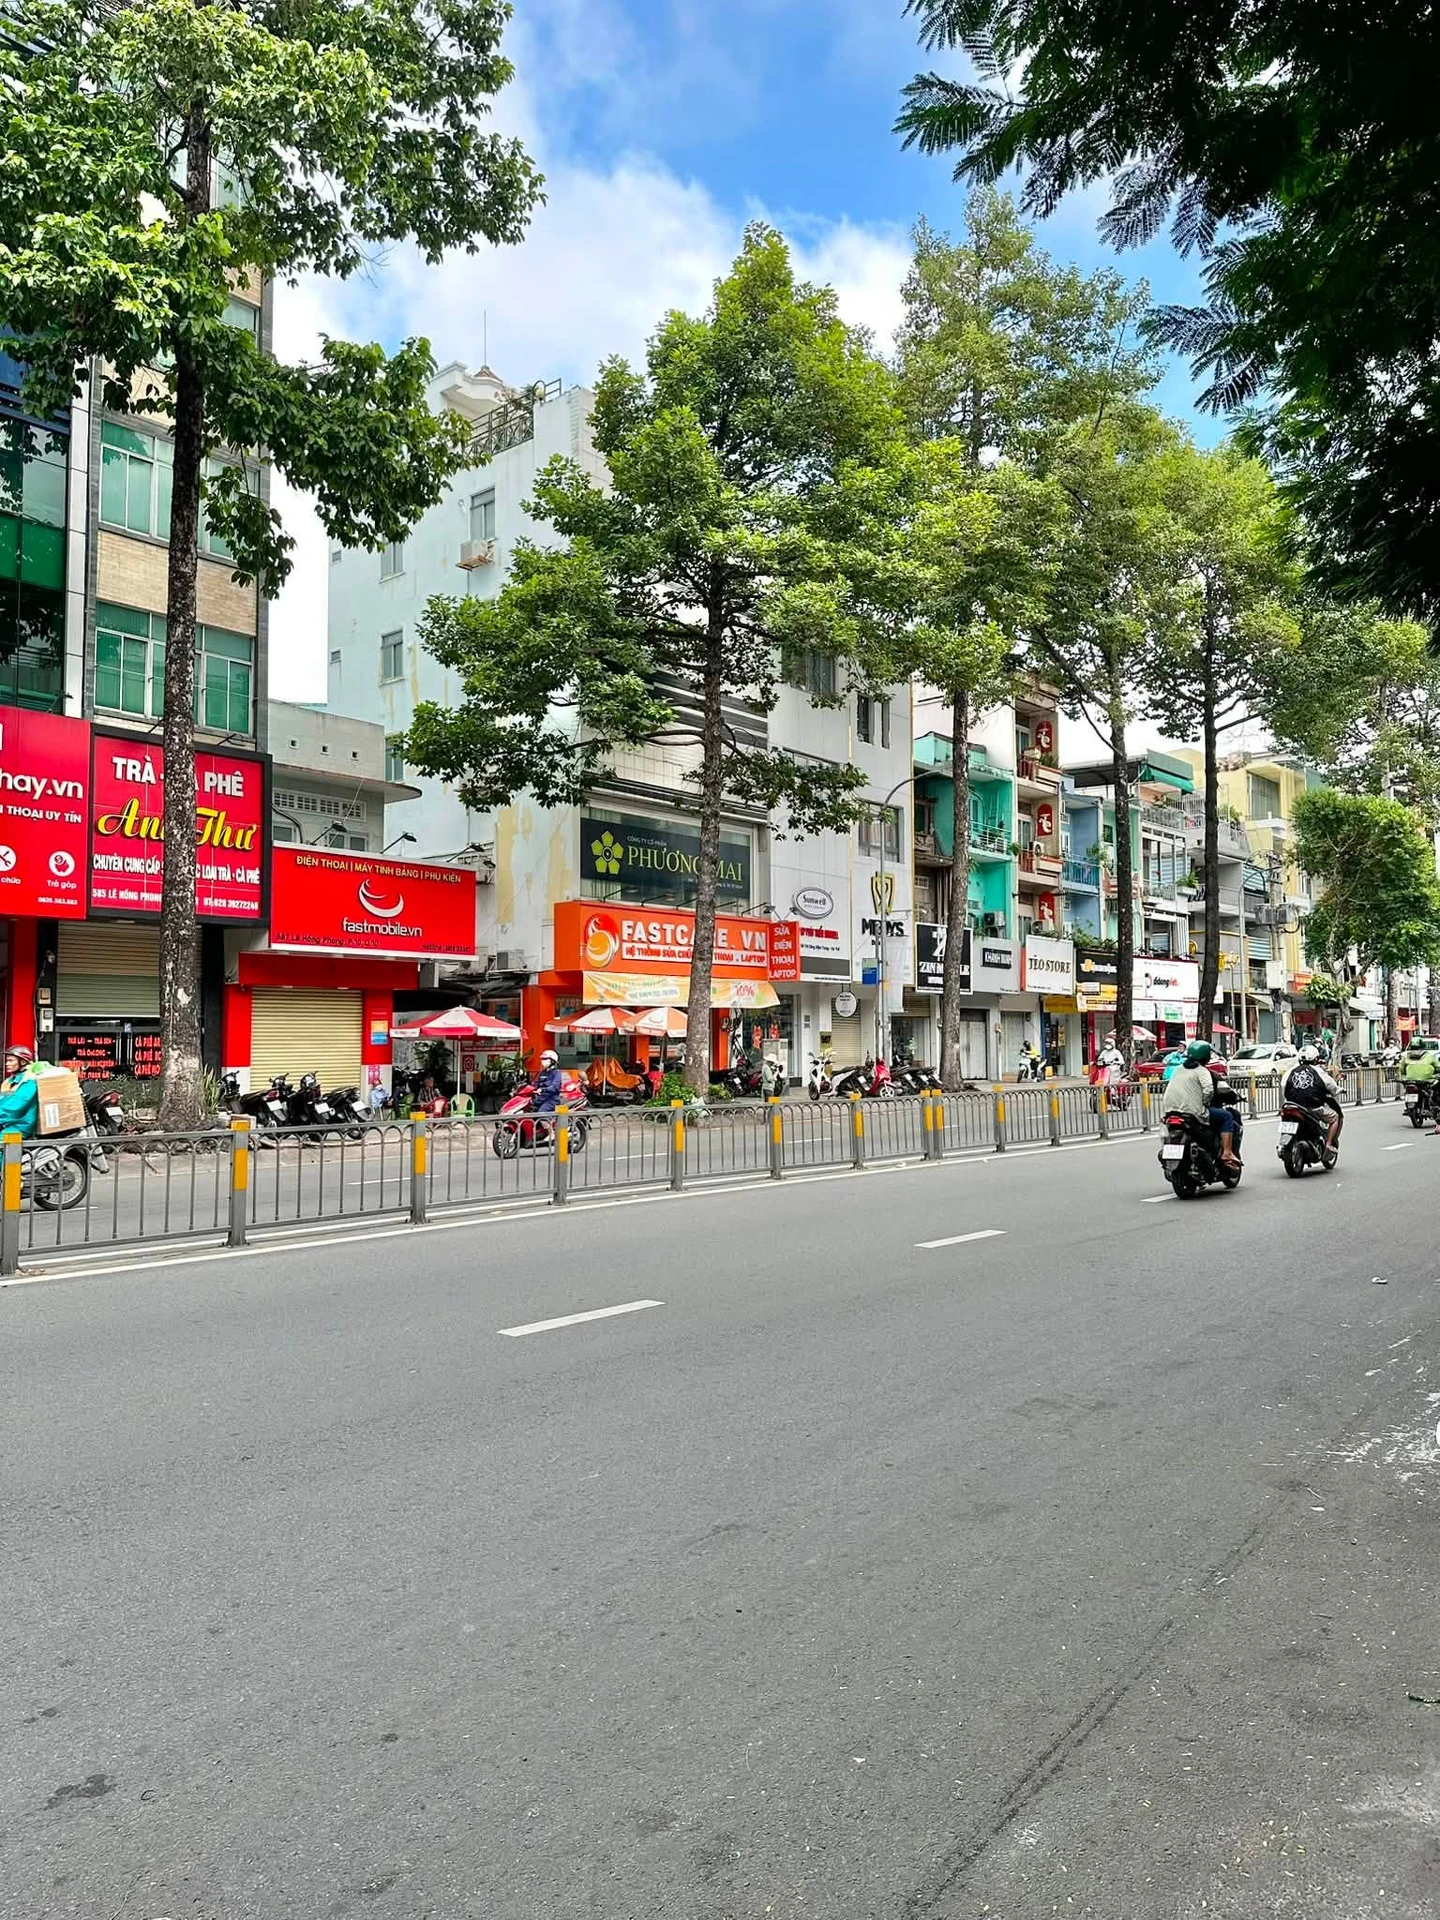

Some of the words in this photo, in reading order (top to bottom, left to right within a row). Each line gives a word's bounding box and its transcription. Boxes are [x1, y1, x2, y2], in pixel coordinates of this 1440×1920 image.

[112, 756, 156, 784] TRÀ
[204, 770, 244, 797] PHÊ
[6, 805, 44, 821] THOẠI
[45, 810, 61, 821] UY
[64, 810, 82, 823] TÍN
[97, 797, 165, 841] An
[93, 852, 123, 871] CHUYÊN
[124, 857, 145, 874] CUNG
[146, 855, 160, 874] CẤP
[218, 864, 232, 881] TRÀ
[236, 865, 246, 883] CÀ
[296, 854, 319, 868] ĐIỆN
[321, 858, 349, 871] THOẠI
[354, 862, 373, 873] MÁY
[375, 864, 394, 875] TÍNH
[424, 871, 441, 882] PHỤ
[442, 872, 461, 884] KIỆN
[342, 916, 422, 937] fastmobile.vn
[769, 969, 796, 979] LAPTOP
[1045, 960, 1071, 974] STORE
